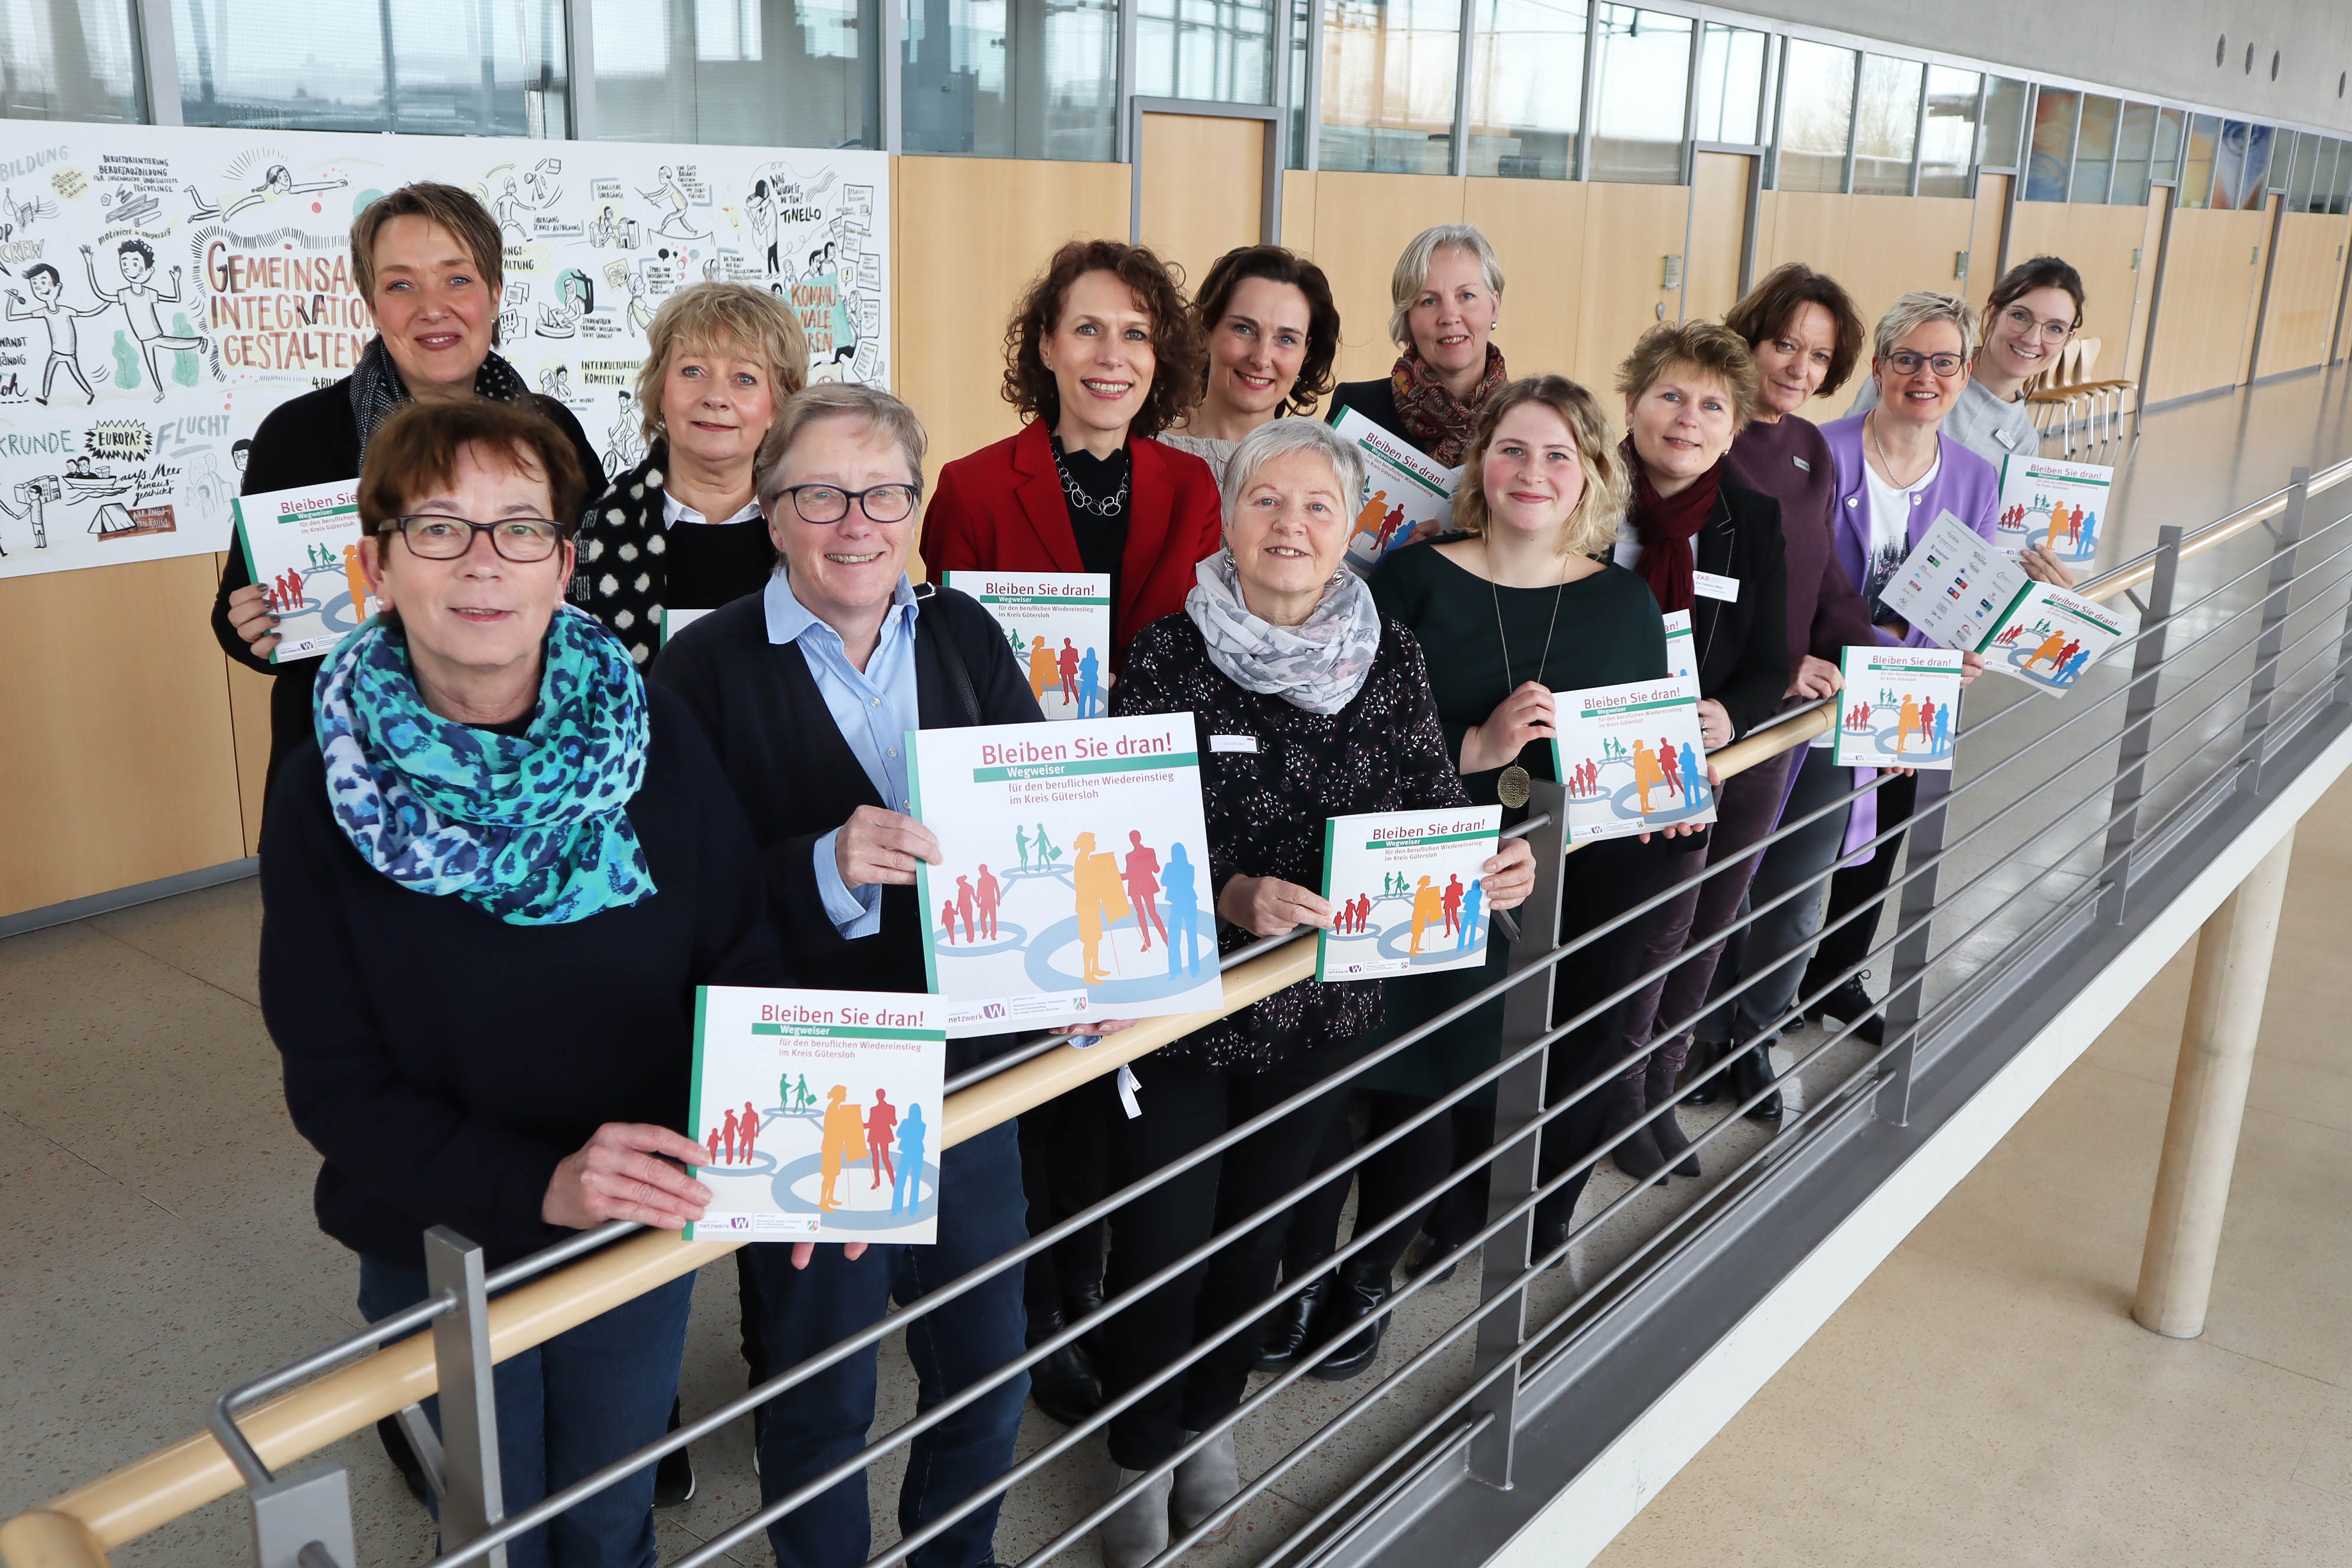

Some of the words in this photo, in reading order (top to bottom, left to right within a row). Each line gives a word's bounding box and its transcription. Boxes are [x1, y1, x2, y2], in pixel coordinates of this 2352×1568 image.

[103, 155, 169, 166] BERUFSORIENTIERUNG
[99, 165, 167, 177] BERUFSAUSBILDUNG
[776, 182, 801, 195] WÜRDEST
[780, 206, 821, 224] TINELLO
[98, 227, 132, 245] motiviert
[0, 239, 44, 264] CREW
[503, 246, 526, 256] ANGS-
[502, 259, 534, 270] ALTUNG
[791, 283, 844, 308] KOMMU-
[224, 331, 367, 370] GESTALTEN
[582, 360, 639, 370] INTERKULTURELLE
[584, 373, 625, 385] KOMPETENZ
[99, 430, 142, 446] EUROPA?
[155, 414, 231, 455] FLUCHT
[1366, 432, 1402, 460] Bleiben
[1402, 455, 1418, 471] Sie
[1419, 467, 1445, 486] dran!
[1371, 446, 1396, 465] Wegweiser
[120, 469, 146, 484] aufs
[149, 463, 182, 480] Meer
[1370, 460, 1381, 471] Kreis
[1381, 468, 1401, 483] Gütersloh
[2030, 464, 2062, 475] Bleiben
[2065, 468, 2078, 477] Sie
[2080, 471, 2102, 479] dran!
[1383, 461, 1405, 479] beruflichen
[1404, 476, 1434, 498] Wiedereinstieg
[133, 487, 174, 507] geschickt
[280, 498, 333, 514] Bleiben
[337, 492, 359, 505] Sie
[297, 509, 333, 520] Wegweiser
[321, 514, 355, 525] beruflichen
[326, 521, 355, 531] Gütersloh
[986, 583, 1034, 594] Bleiben
[1038, 584, 1058, 595] Sie
[1062, 584, 1095, 596] dran!
[2049, 593, 2079, 609] Bleiben
[2080, 606, 2094, 616] Sie
[2095, 614, 2118, 627] dran!
[1665, 620, 1679, 632] an!
[1873, 655, 1907, 665] Bleiben
[1910, 657, 1925, 665] Sie
[1928, 658, 1951, 667] dran!
[1584, 695, 1627, 710] Bleiben
[1631, 691, 1648, 703] Sie
[1651, 687, 1681, 700] dran!
[1597, 707, 1626, 715] Wegweiser
[1616, 711, 1644, 720] beruflichen
[1645, 707, 1683, 717] Wiedereinstieg
[981, 741, 1067, 766] Bleiben
[1074, 737, 1108, 759] Sie
[1115, 732, 1172, 756] dran!
[1007, 765, 1065, 779] Wegweiser
[1008, 783, 1022, 792] für
[1024, 781, 1043, 792] den
[1046, 777, 1100, 790] beruflichen
[1102, 772, 1174, 786] Wiedereinstieg
[1010, 795, 1021, 804] im
[1024, 793, 1049, 803] Kreis
[1051, 789, 1099, 803] Gütersloh
[1373, 827, 1423, 840] Bleiben
[1428, 824, 1448, 836] Sie
[1452, 819, 1485, 833] dran!
[1386, 838, 1420, 847] Wegweiser
[1407, 845, 1439, 854] beruflichen
[1440, 841, 1482, 851] Wiedereinstieg
[1409, 852, 1438, 860] Gütersloh
[762, 1005, 833, 1024] Bleiben
[841, 1008, 870, 1025] Sie
[876, 1010, 924, 1027] dran!
[949, 1012, 984, 1023] netzwerk
[780, 1025, 830, 1036] Wegweiser
[779, 1038, 791, 1047] für
[811, 1039, 857, 1050] beruflichen
[860, 1041, 921, 1052] Wiedereinstieg
[791, 1048, 812, 1057] Kreis
[815, 1049, 855, 1059] Gütersloh
